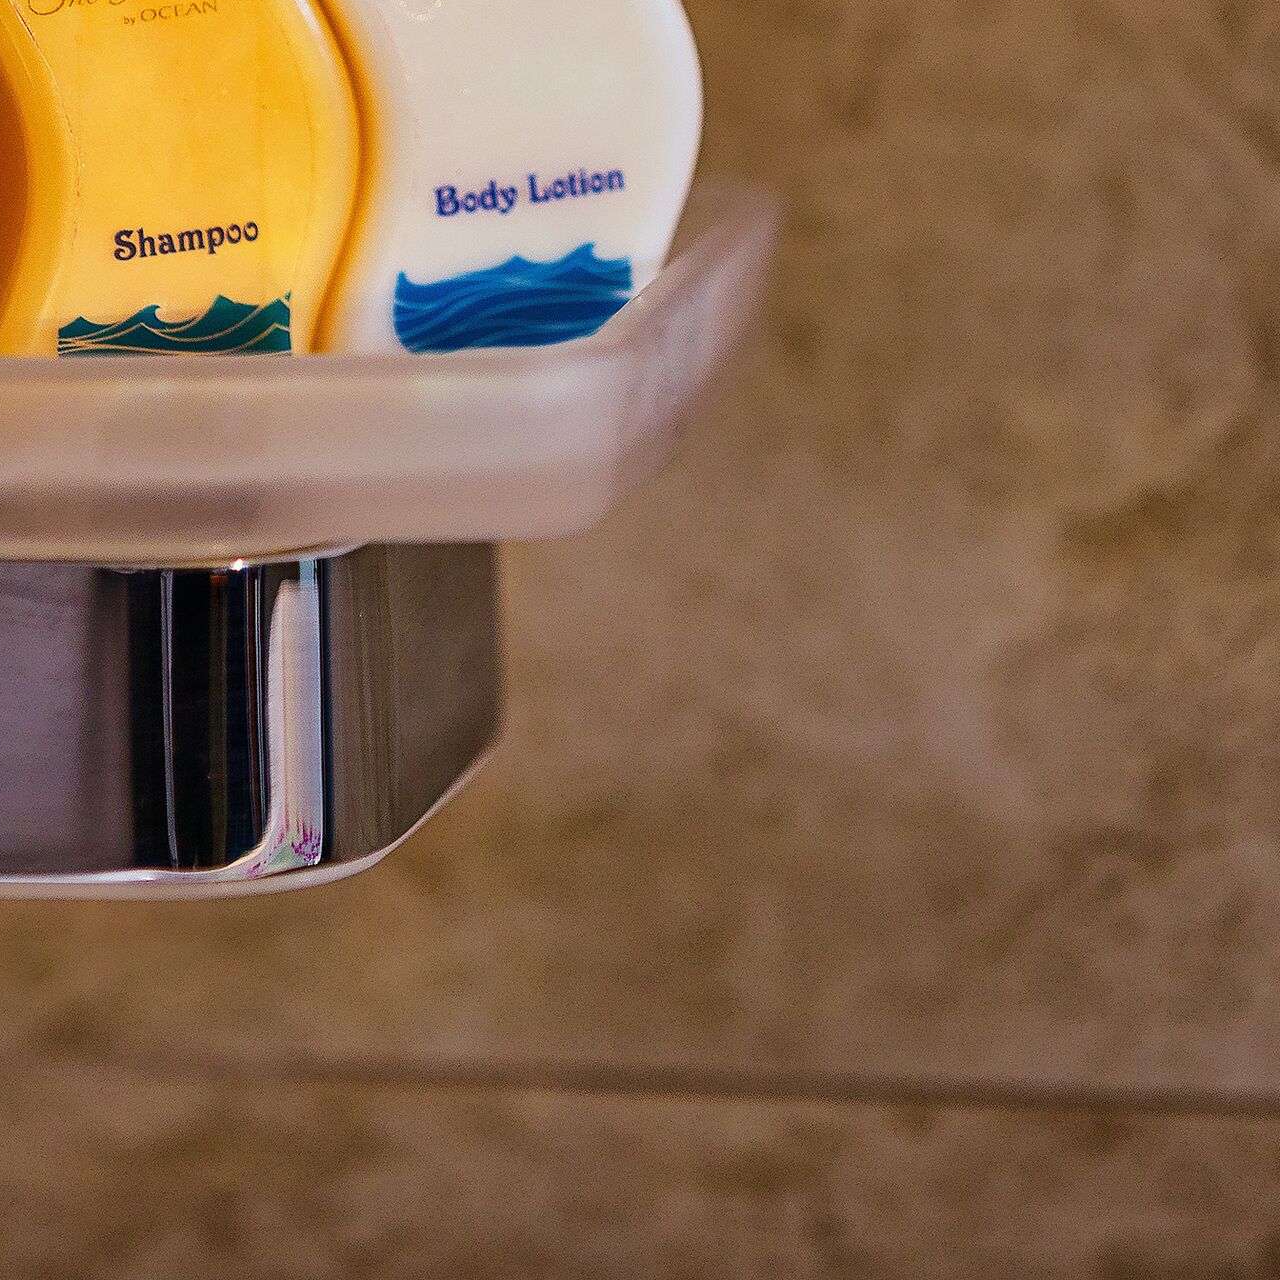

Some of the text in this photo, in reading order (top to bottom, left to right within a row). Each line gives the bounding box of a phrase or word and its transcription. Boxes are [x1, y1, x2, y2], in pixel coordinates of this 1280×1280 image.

[123, 0, 218, 26] by OCEAN
[434, 168, 625, 217] Body Lotion
[113, 221, 259, 261] Shampoo
